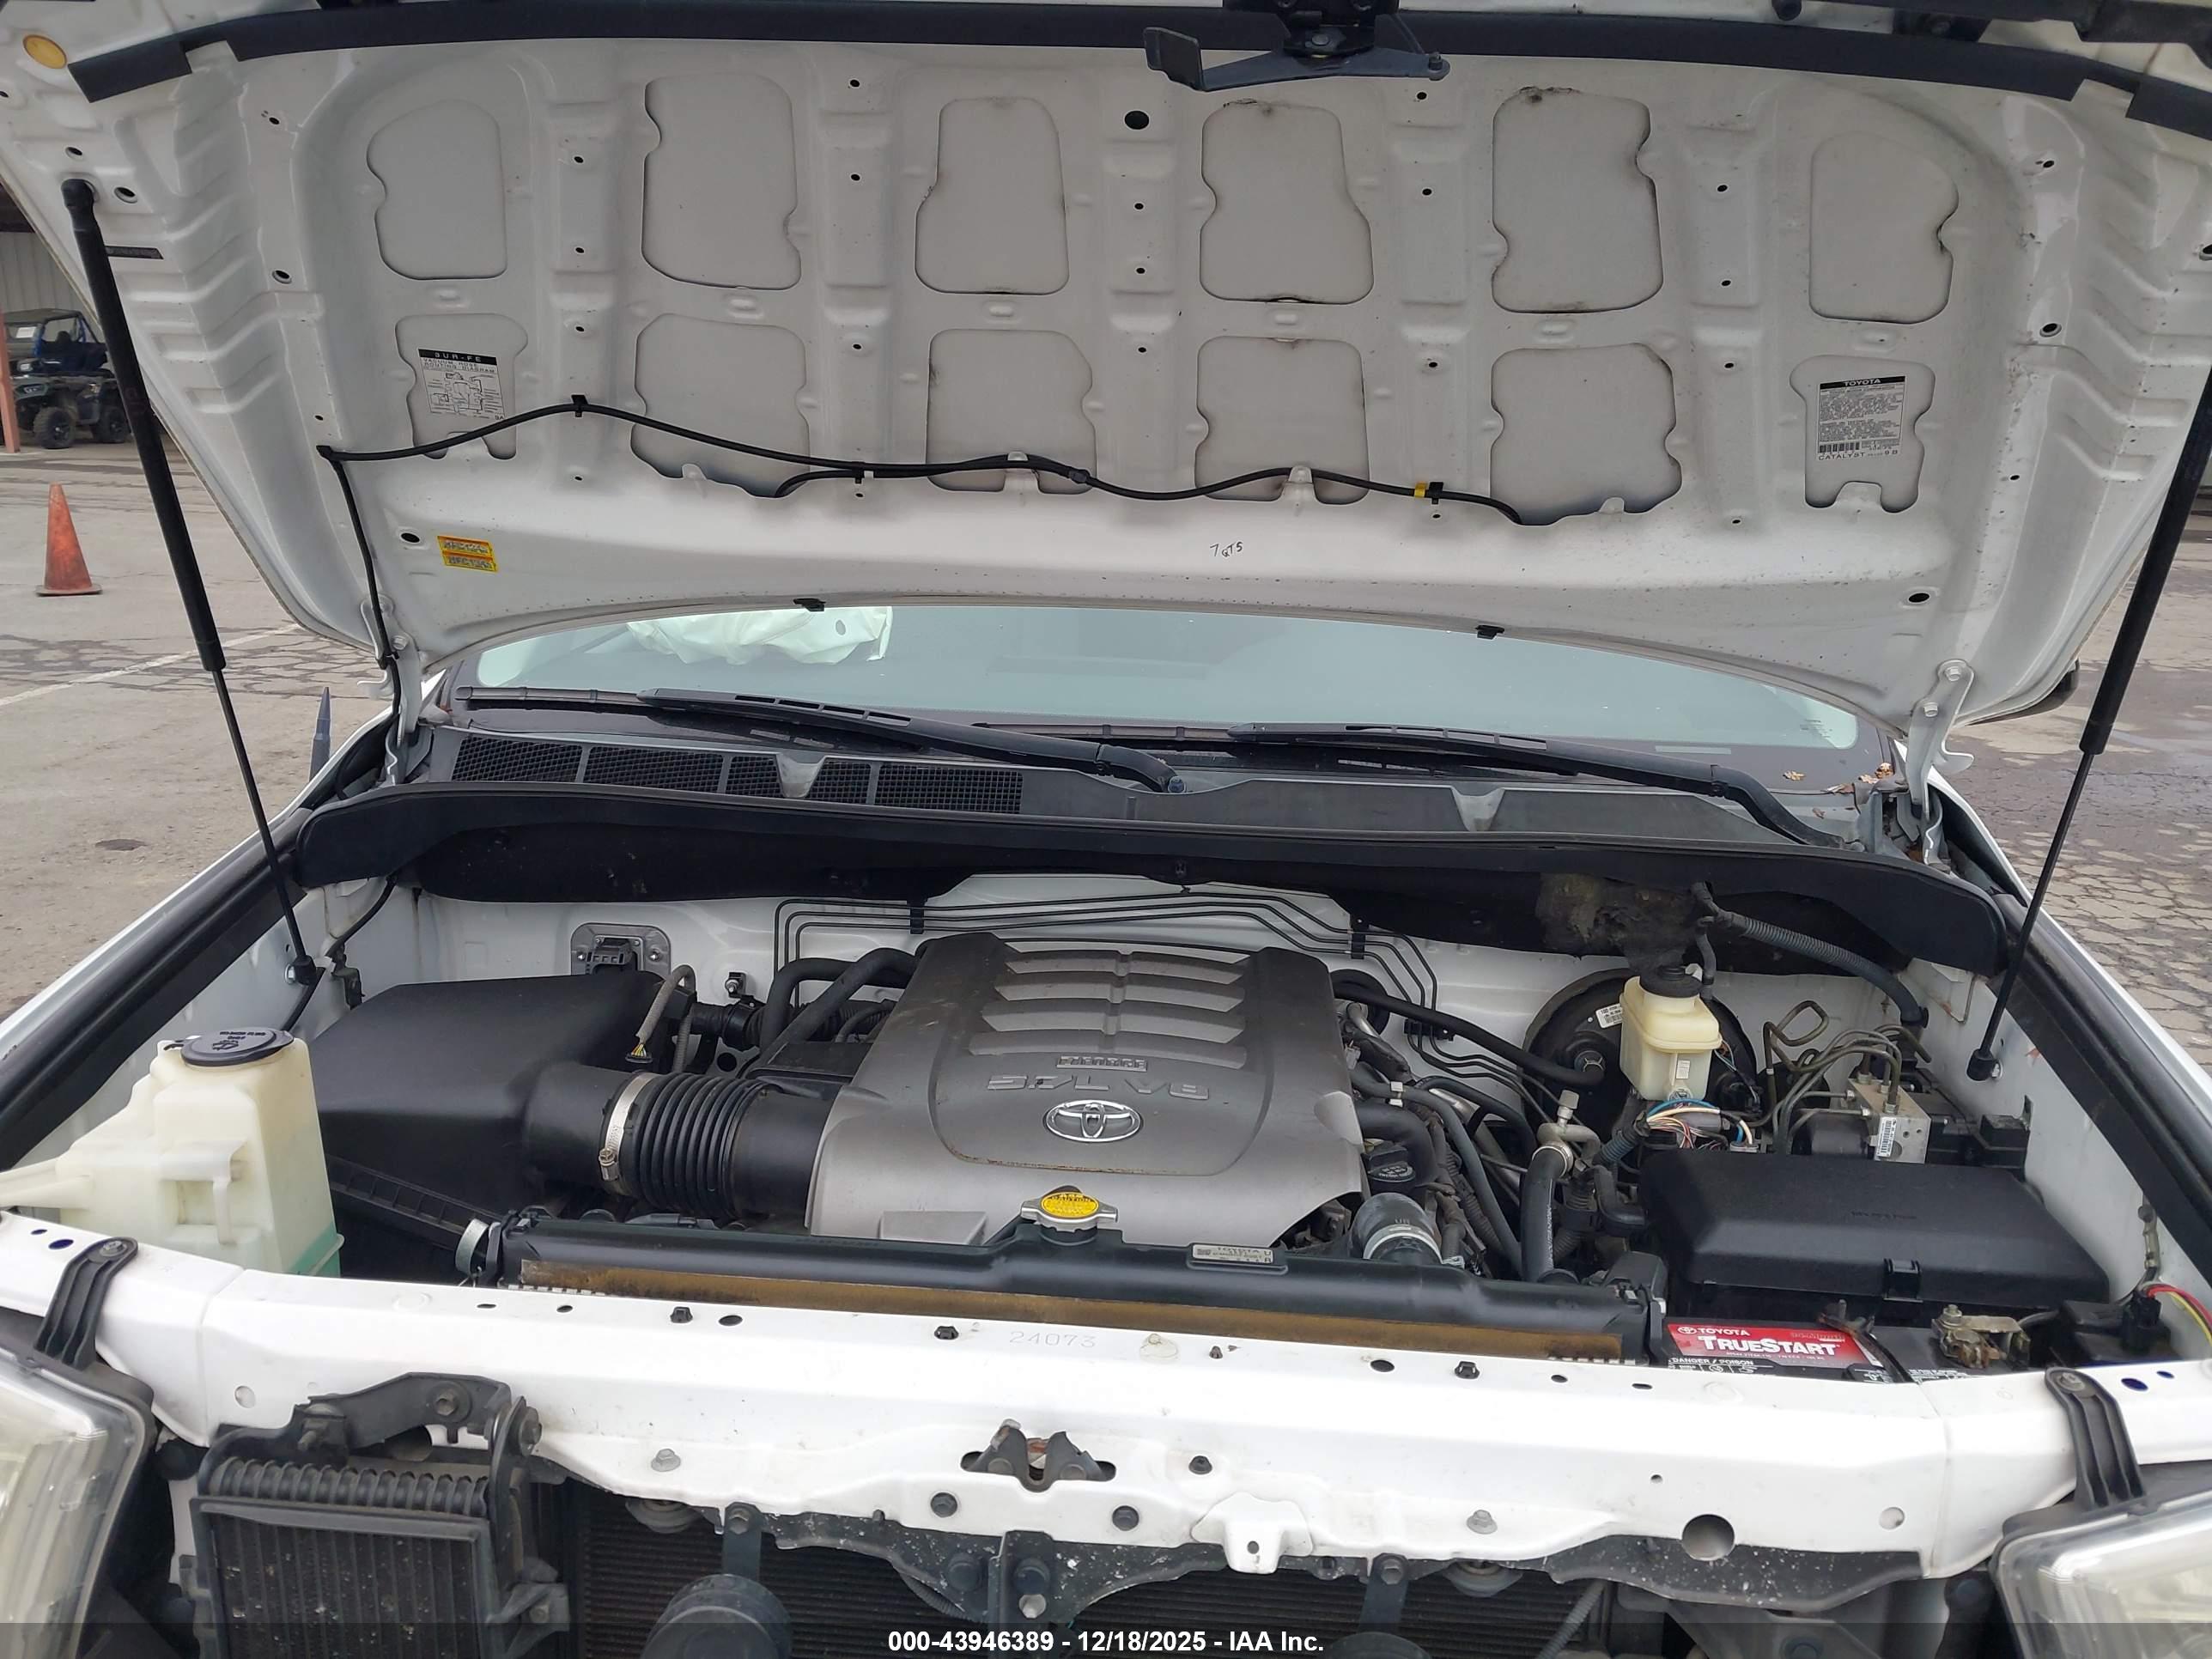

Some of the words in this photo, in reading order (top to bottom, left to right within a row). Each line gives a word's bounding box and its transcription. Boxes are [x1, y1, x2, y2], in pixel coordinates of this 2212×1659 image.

[1844, 378, 1881, 386] TOYOTA
[1819, 452, 1865, 461] CATALYST
[1124, 1079, 1209, 1099] V8
[1698, 1328, 1750, 1336] TOYOTA
[1010, 1331, 1097, 1348] 24073
